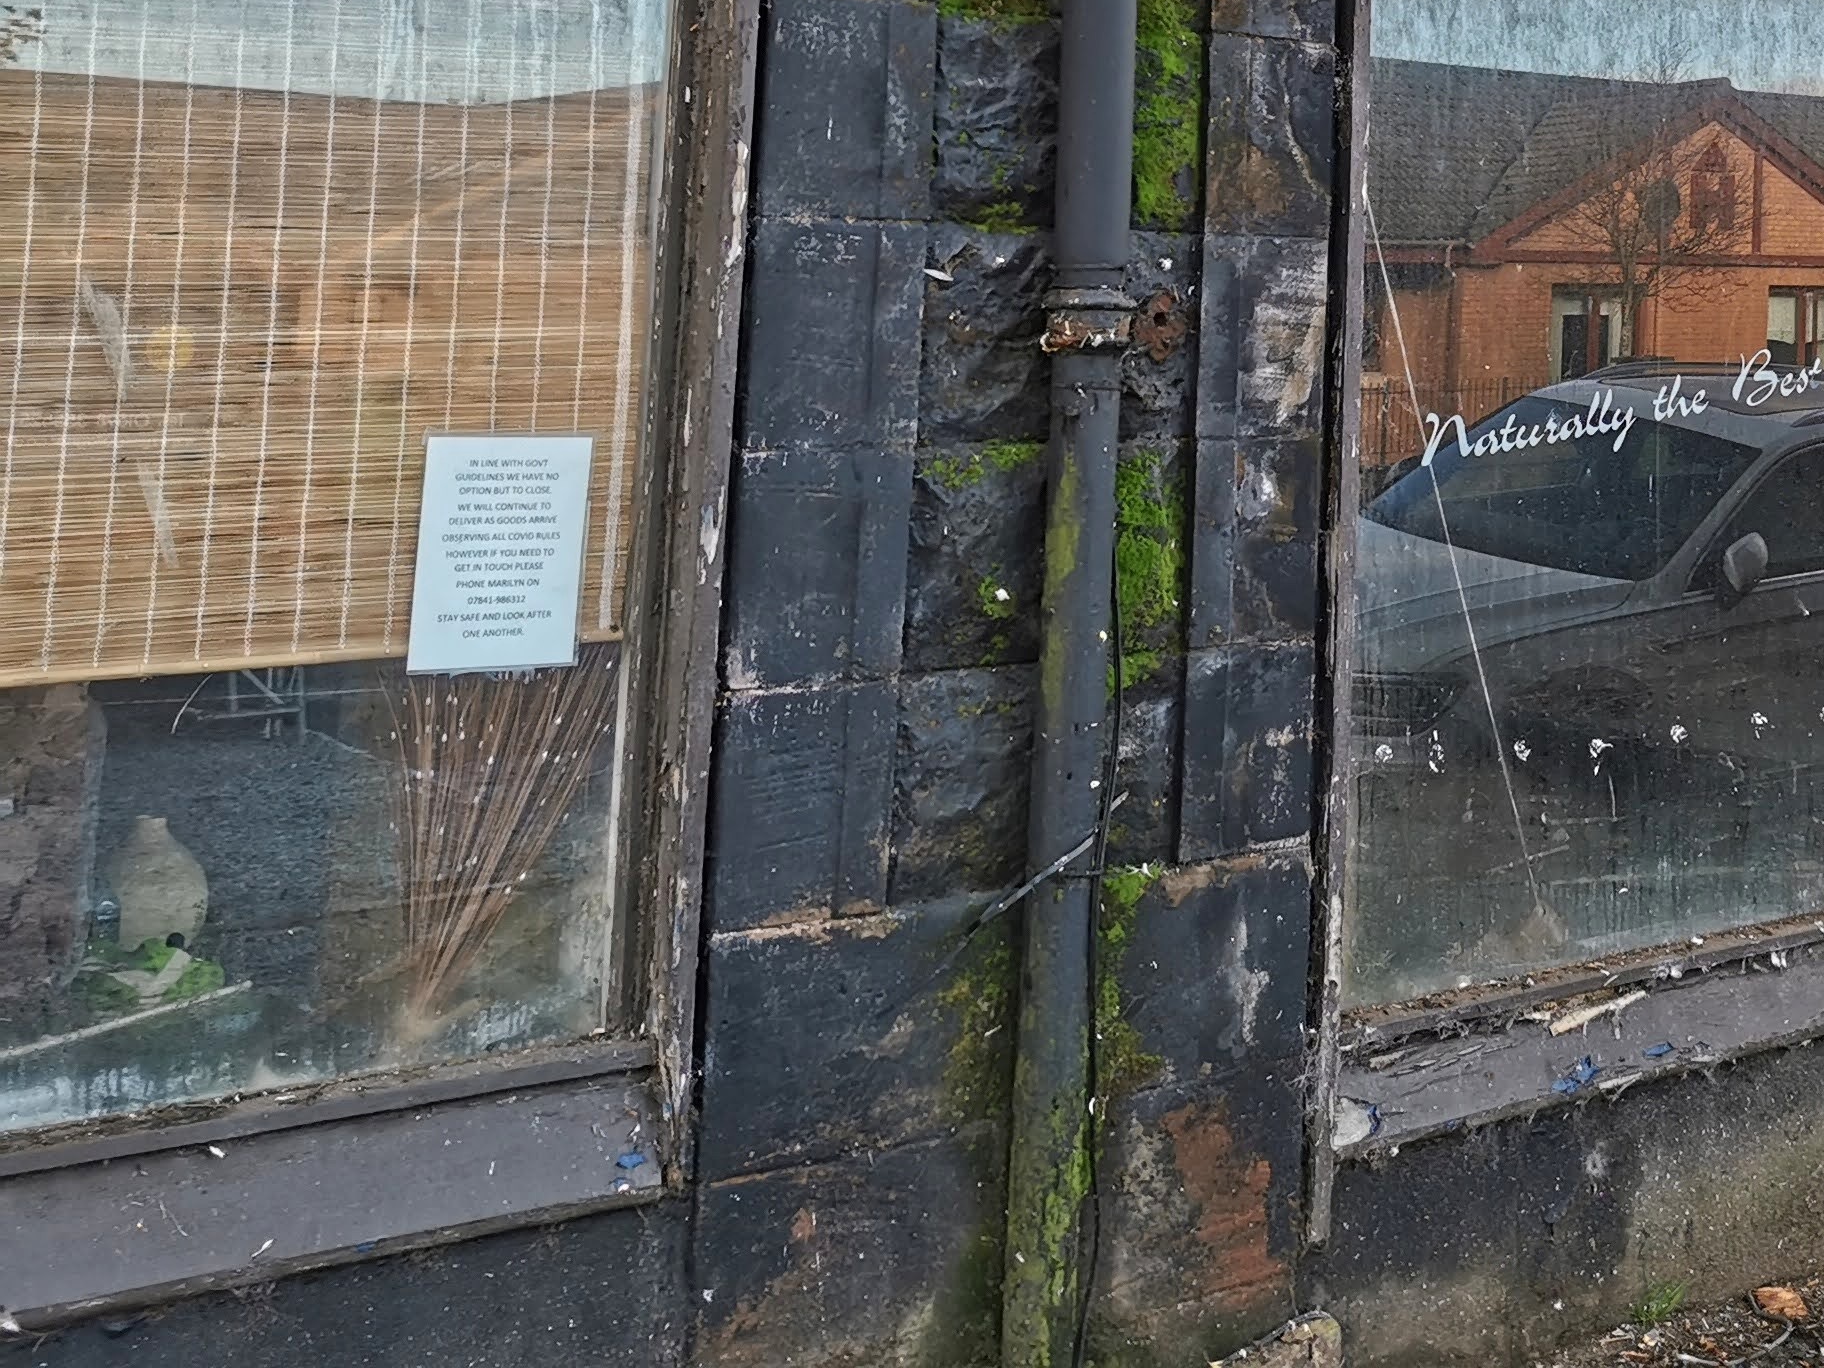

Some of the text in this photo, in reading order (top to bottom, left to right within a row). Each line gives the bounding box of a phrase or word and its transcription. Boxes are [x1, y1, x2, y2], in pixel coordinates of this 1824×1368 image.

[1421, 348, 1823, 467] Naturally the Best
[469, 458, 549, 468] IN LINE WITH GOVT
[455, 472, 560, 482] GUIDELINES WE HAVE NO
[459, 486, 492, 495] OPTION
[493, 486, 511, 495] BUT
[512, 486, 524, 495] TO
[457, 502, 552, 511] WE WILL CONTINUE TO
[448, 515, 558, 525] DELIVER AS GOODS ARRIVE
[441, 531, 561, 543] OBSERVING ALL COVID RULES
[445, 548, 555, 559] HOWEVER IF YOU NEED TO
[454, 561, 545, 572] GET IN TOUCH PLEASE
[456, 578, 540, 589] PHONE MARILYN ON
[437, 610, 553, 623] STAY SAFE AND LOOK AFTER
[462, 629, 481, 638] ONE
